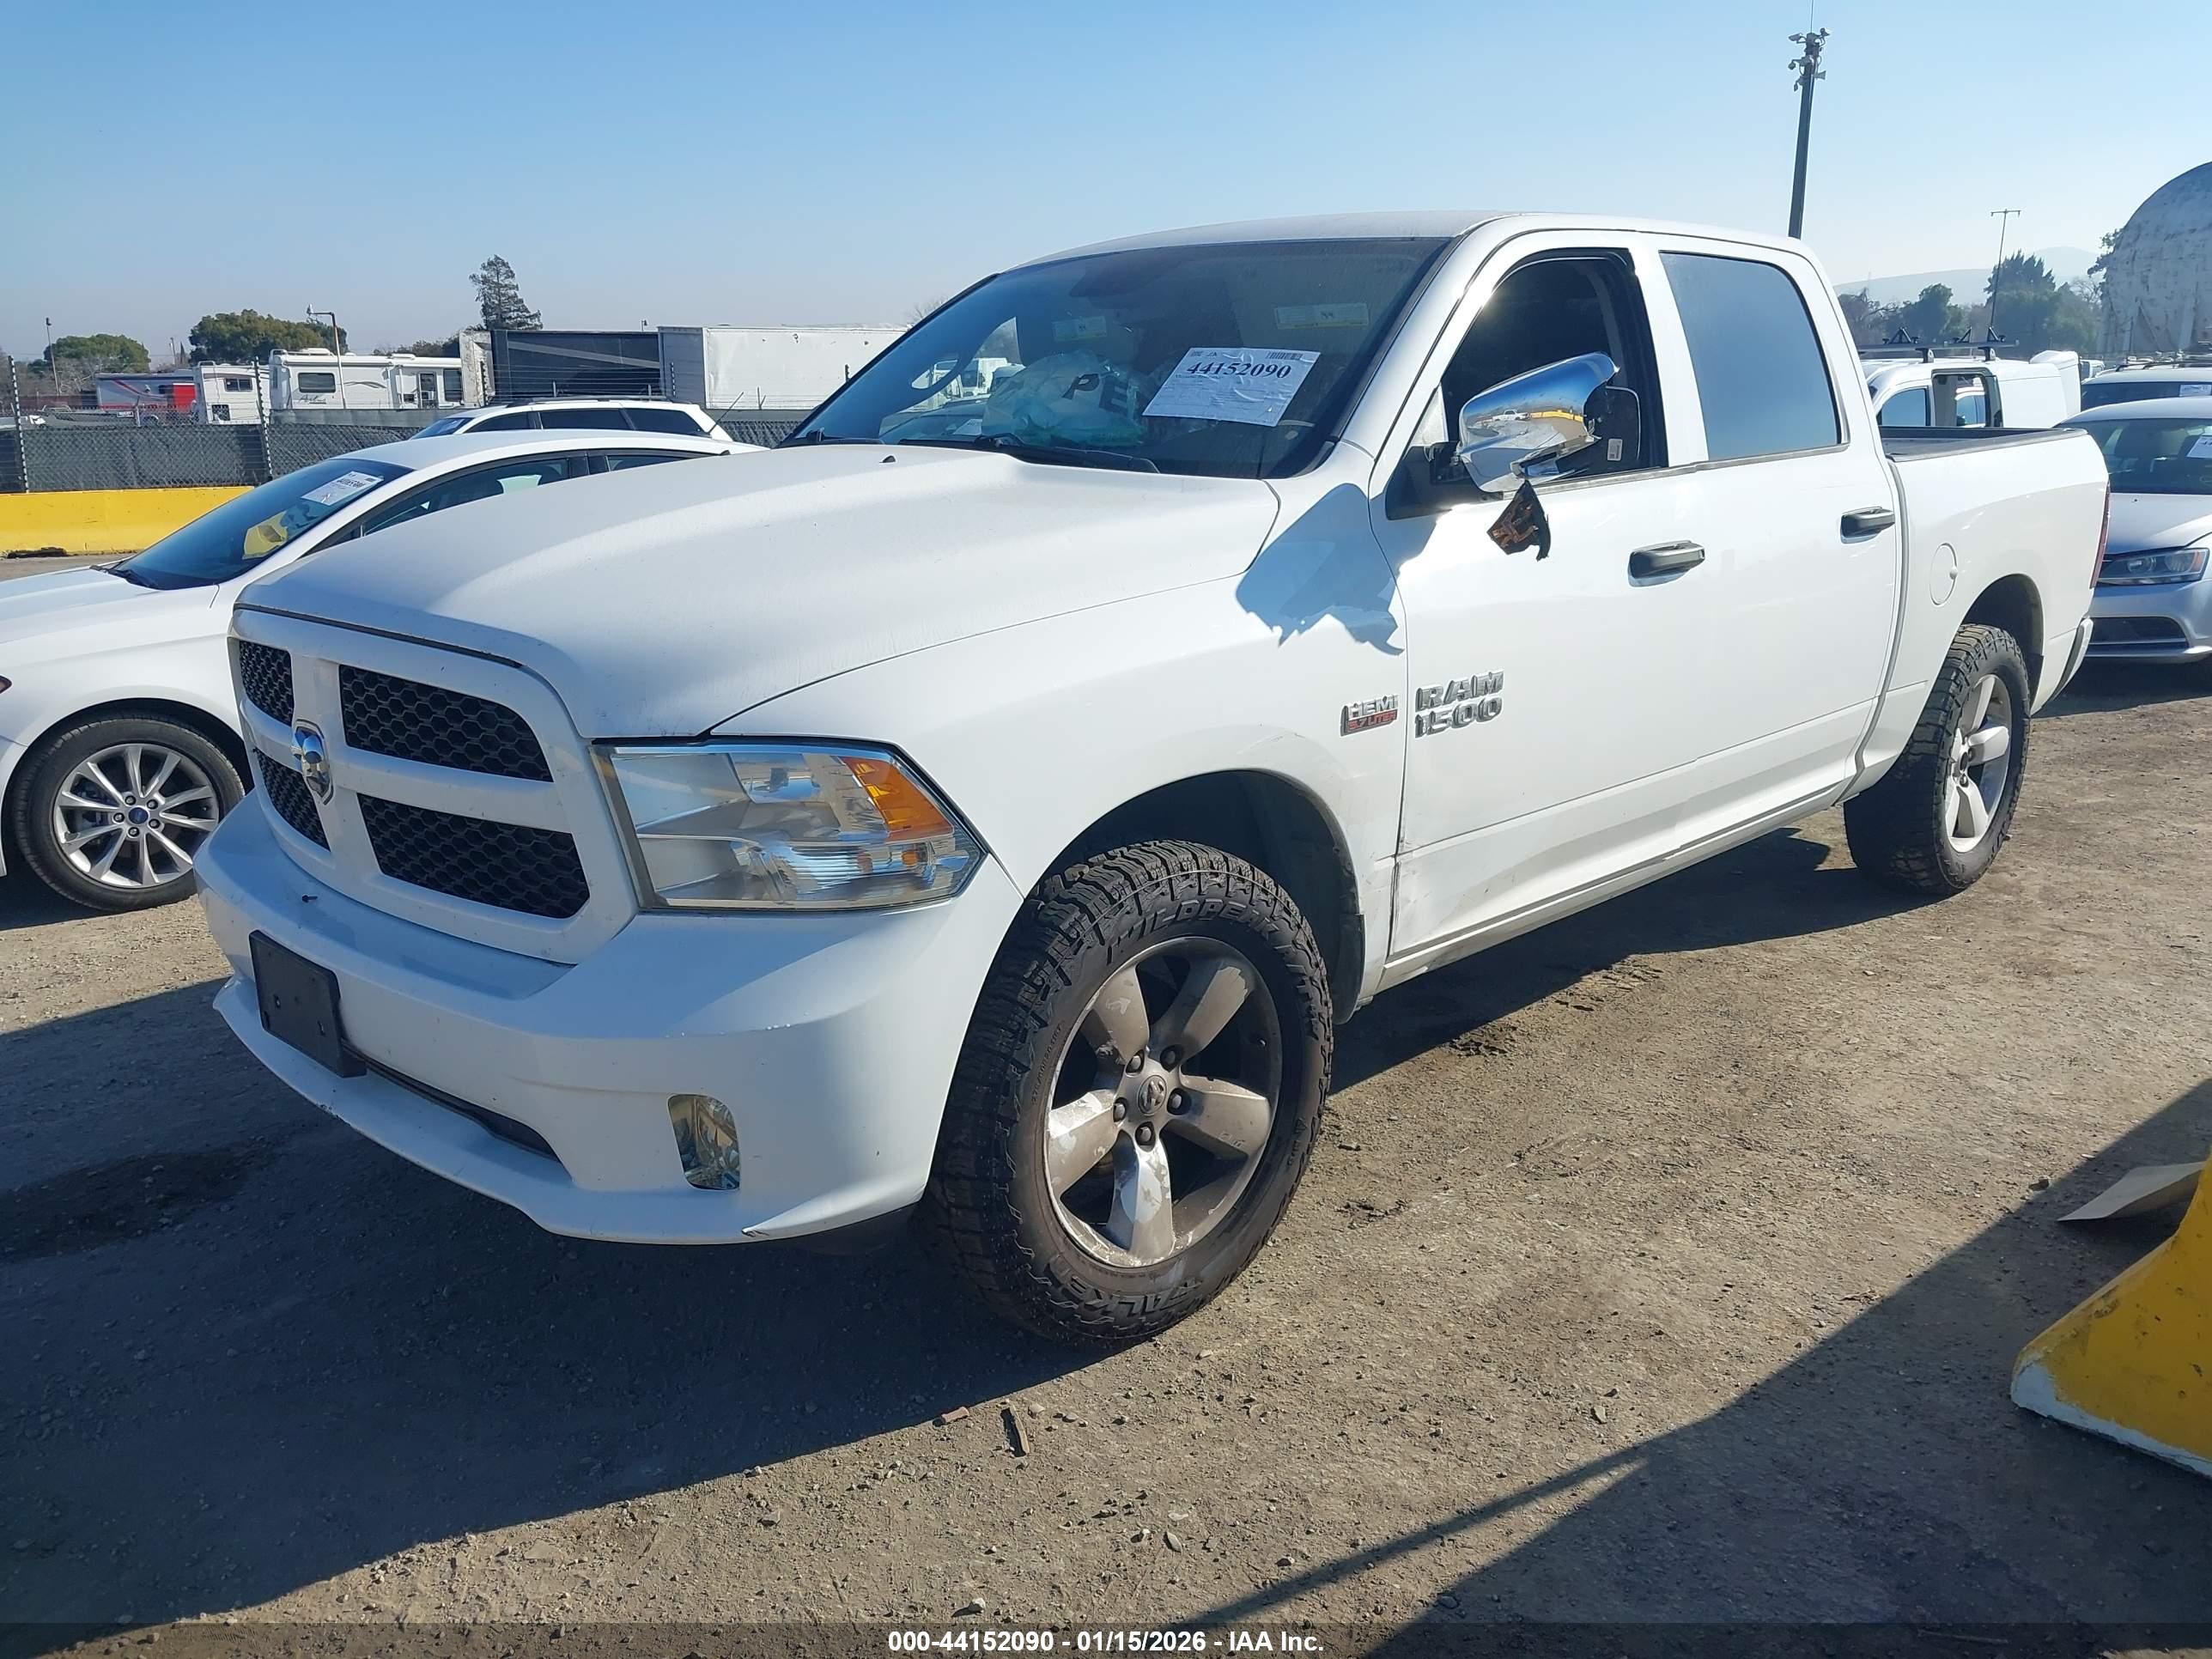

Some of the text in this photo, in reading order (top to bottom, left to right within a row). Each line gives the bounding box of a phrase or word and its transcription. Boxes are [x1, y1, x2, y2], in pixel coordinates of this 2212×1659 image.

[1186, 362, 1291, 379] 44152090
[1414, 667, 1505, 713] RAM
[1346, 693, 1400, 720] HEMI
[1367, 710, 1397, 726] LITER
[1414, 694, 1504, 738] 1500
